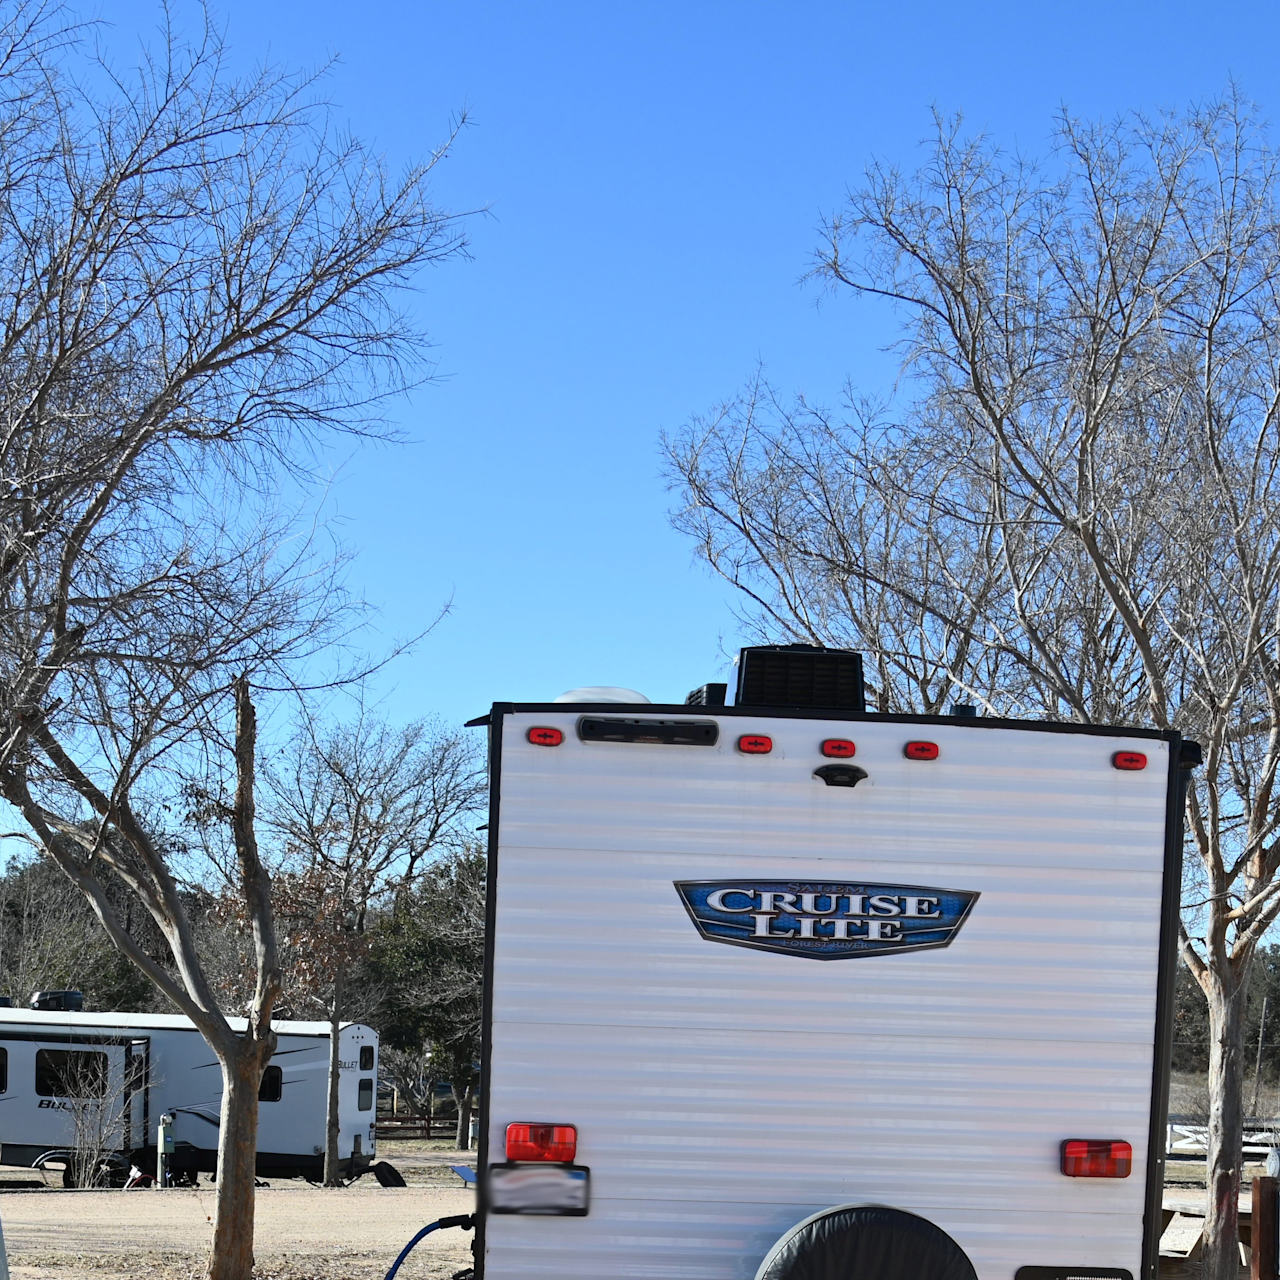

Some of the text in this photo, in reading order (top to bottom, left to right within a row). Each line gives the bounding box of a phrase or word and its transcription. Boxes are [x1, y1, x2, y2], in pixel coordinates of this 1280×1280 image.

[787, 882, 865, 893] SALEM
[706, 888, 941, 919] CRUISE
[749, 914, 904, 942] LITE
